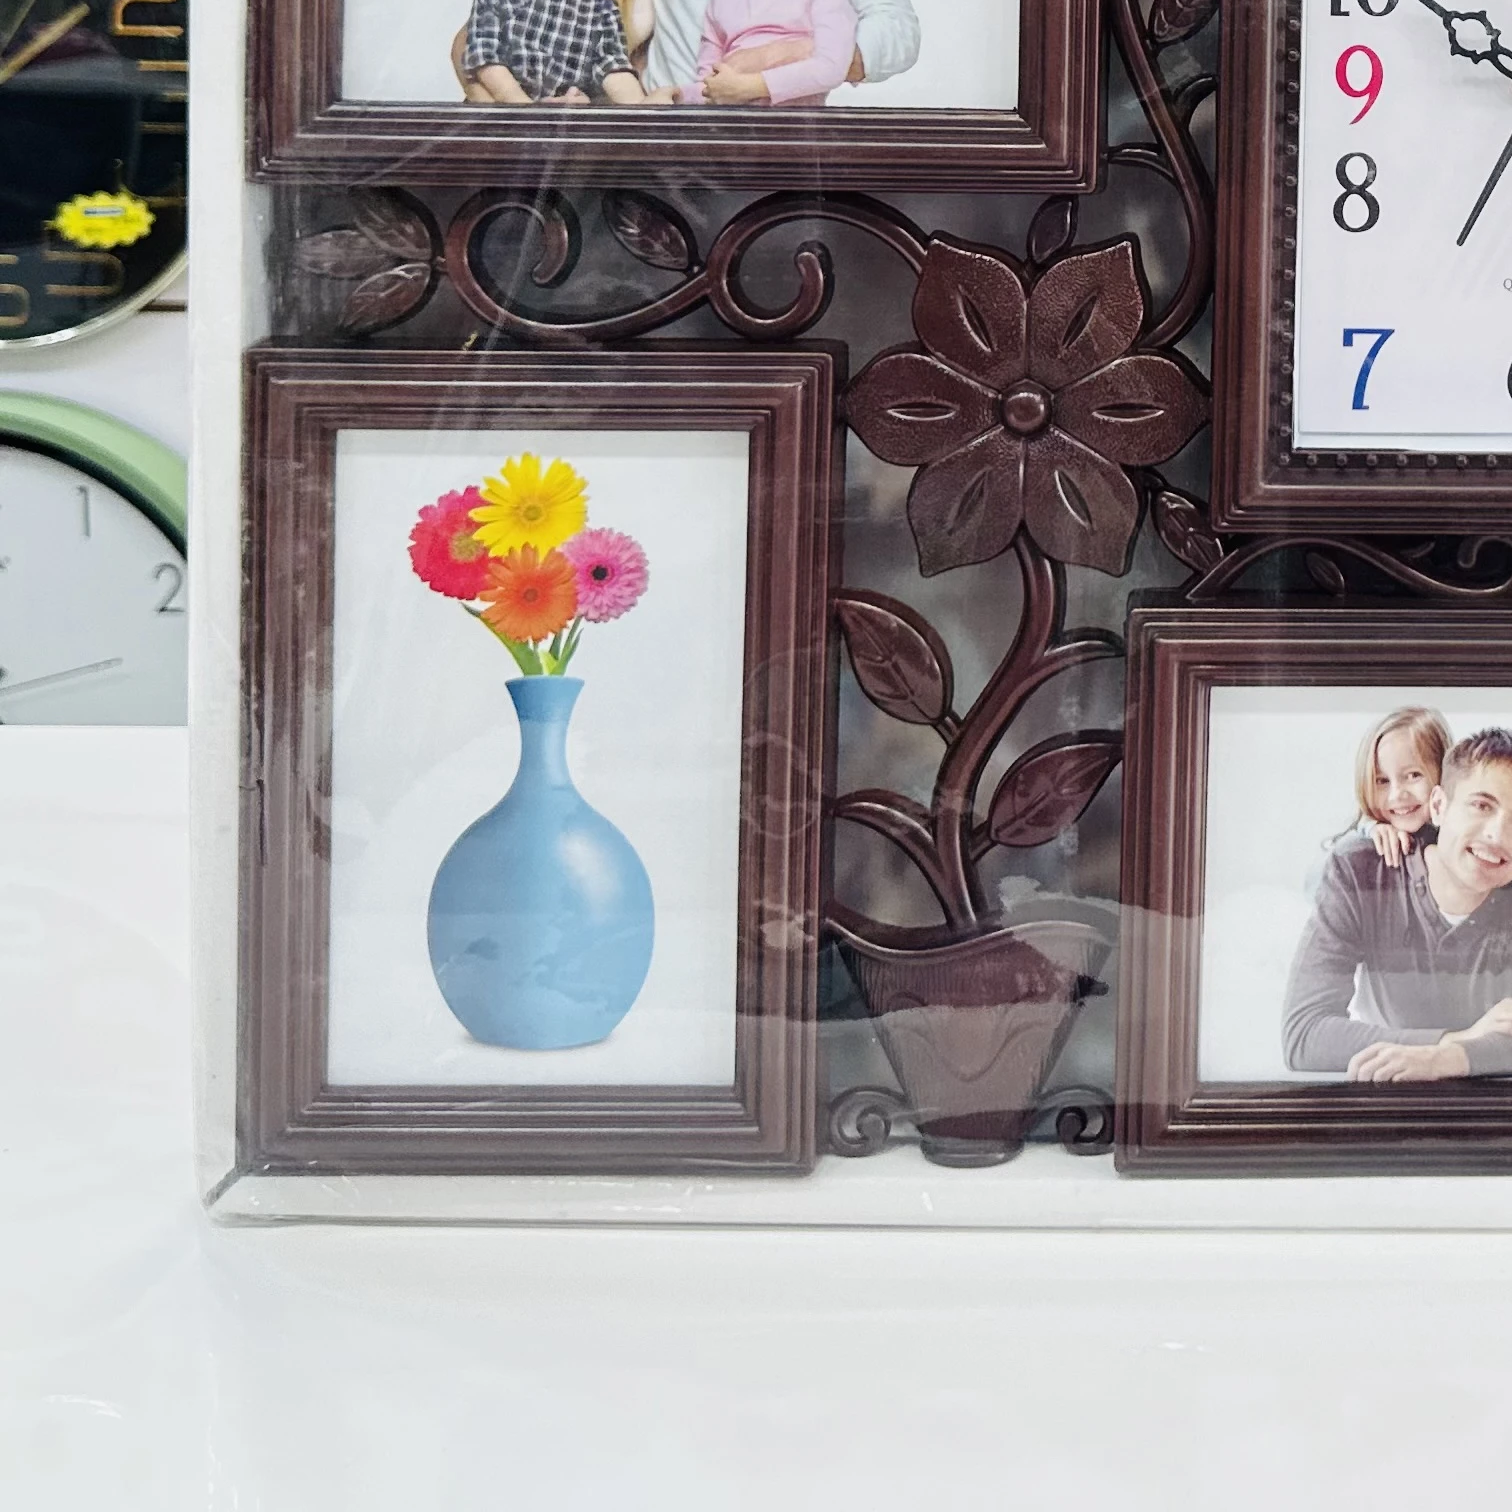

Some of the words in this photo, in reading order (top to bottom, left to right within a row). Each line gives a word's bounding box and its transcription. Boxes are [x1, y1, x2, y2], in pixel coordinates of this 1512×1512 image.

[1335, 44, 1383, 125] 9
[1333, 152, 1380, 233] 8
[1342, 327, 1395, 410] 7
[76, 486, 91, 537] 1
[153, 561, 186, 612] 2
